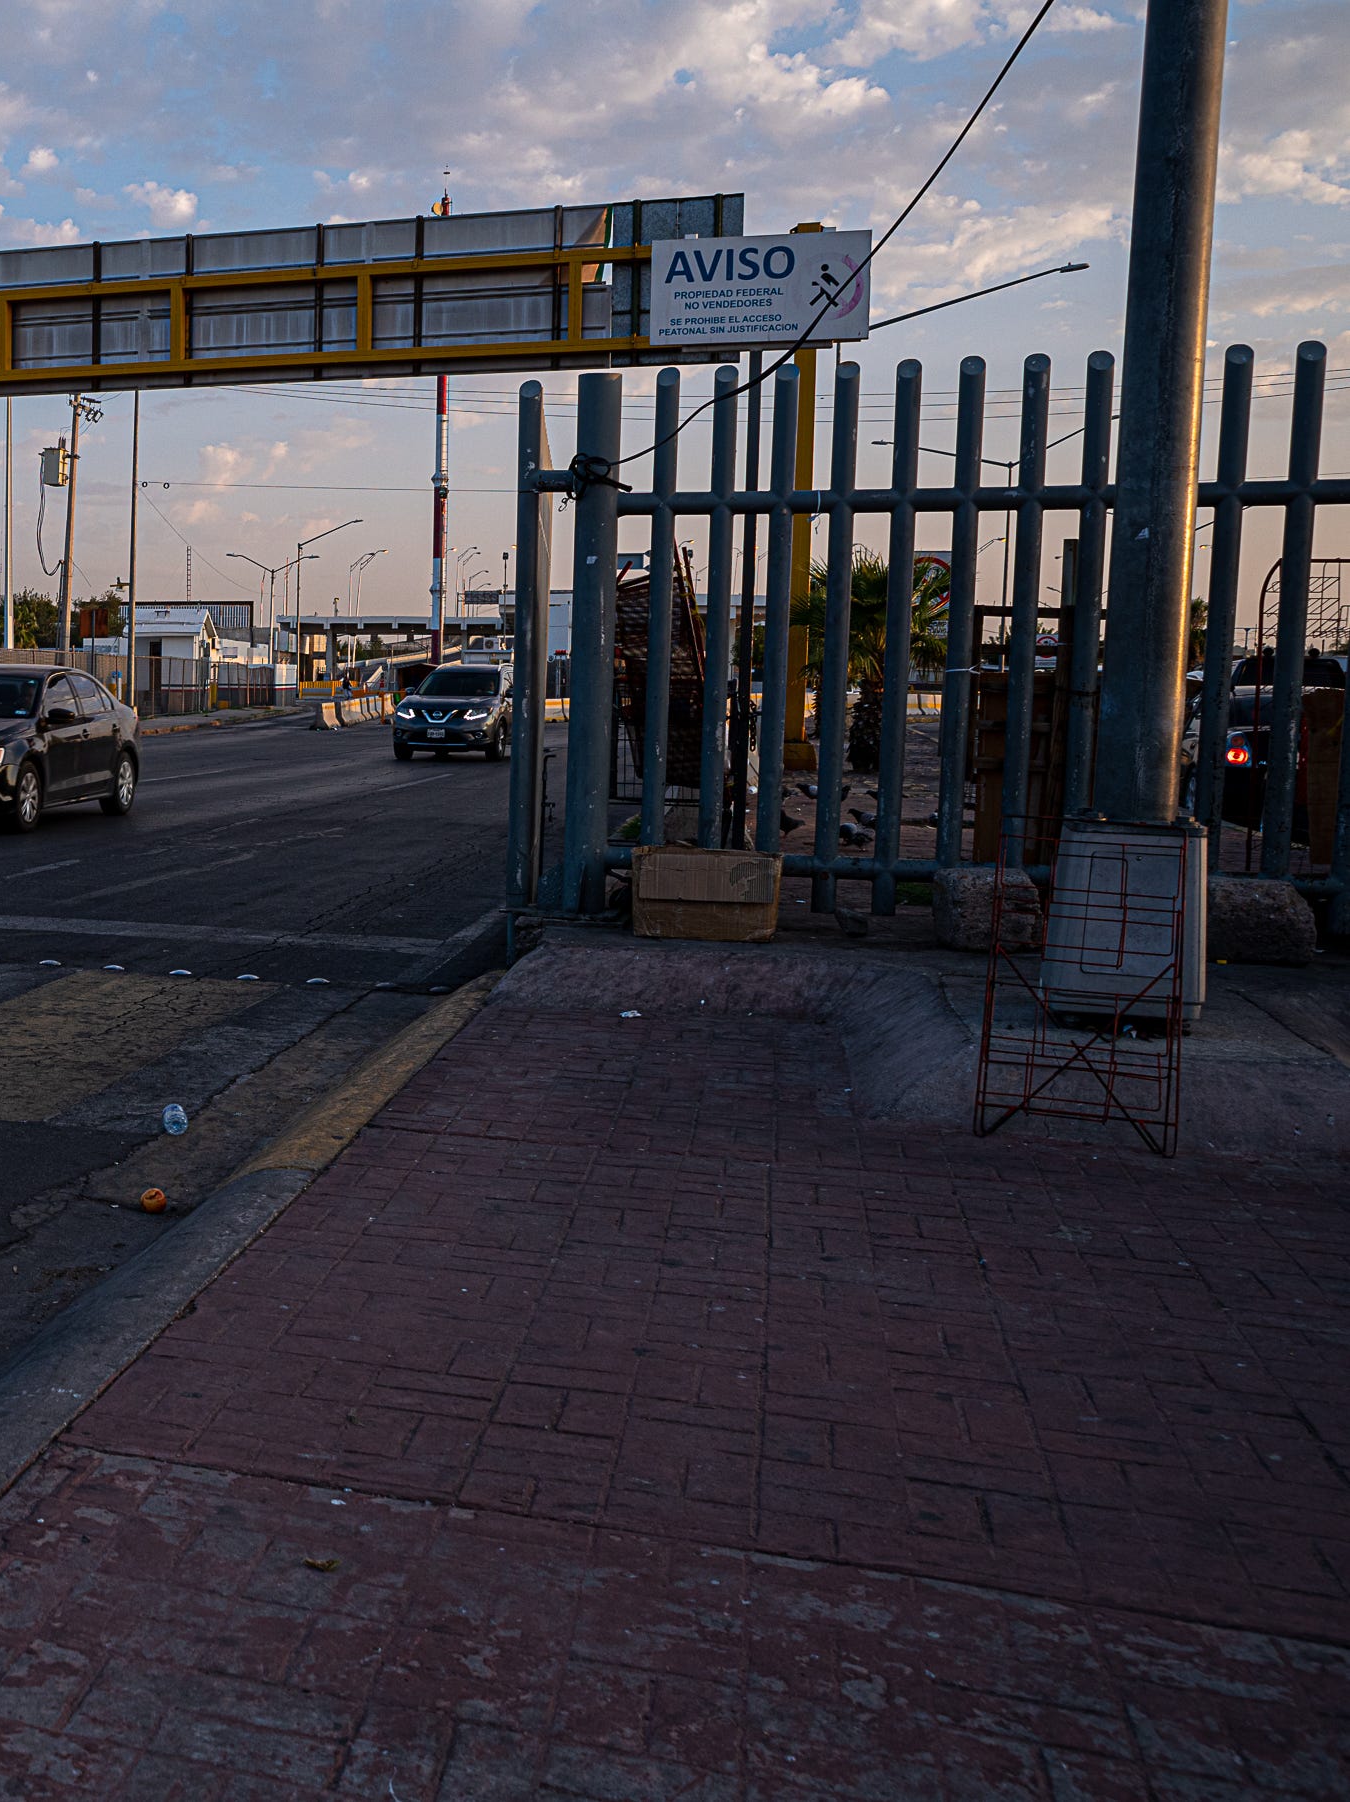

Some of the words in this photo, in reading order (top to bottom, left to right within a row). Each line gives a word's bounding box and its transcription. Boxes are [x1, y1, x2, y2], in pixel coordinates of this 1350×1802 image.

[665, 245, 795, 284] AVISO
[674, 289, 733, 300] PROPIEDAD
[736, 287, 784, 297] FEDERAL
[684, 301, 700, 310] NO
[702, 298, 773, 309] VENDEDORES
[670, 318, 683, 326] SE
[684, 316, 727, 325] PROHIBE
[728, 315, 741, 323] EL
[742, 314, 782, 323] ACCESO
[658, 327, 708, 336] PEATONAL
[709, 325, 725, 334] SIN
[727, 323, 799, 333] JUSTIFICACION
